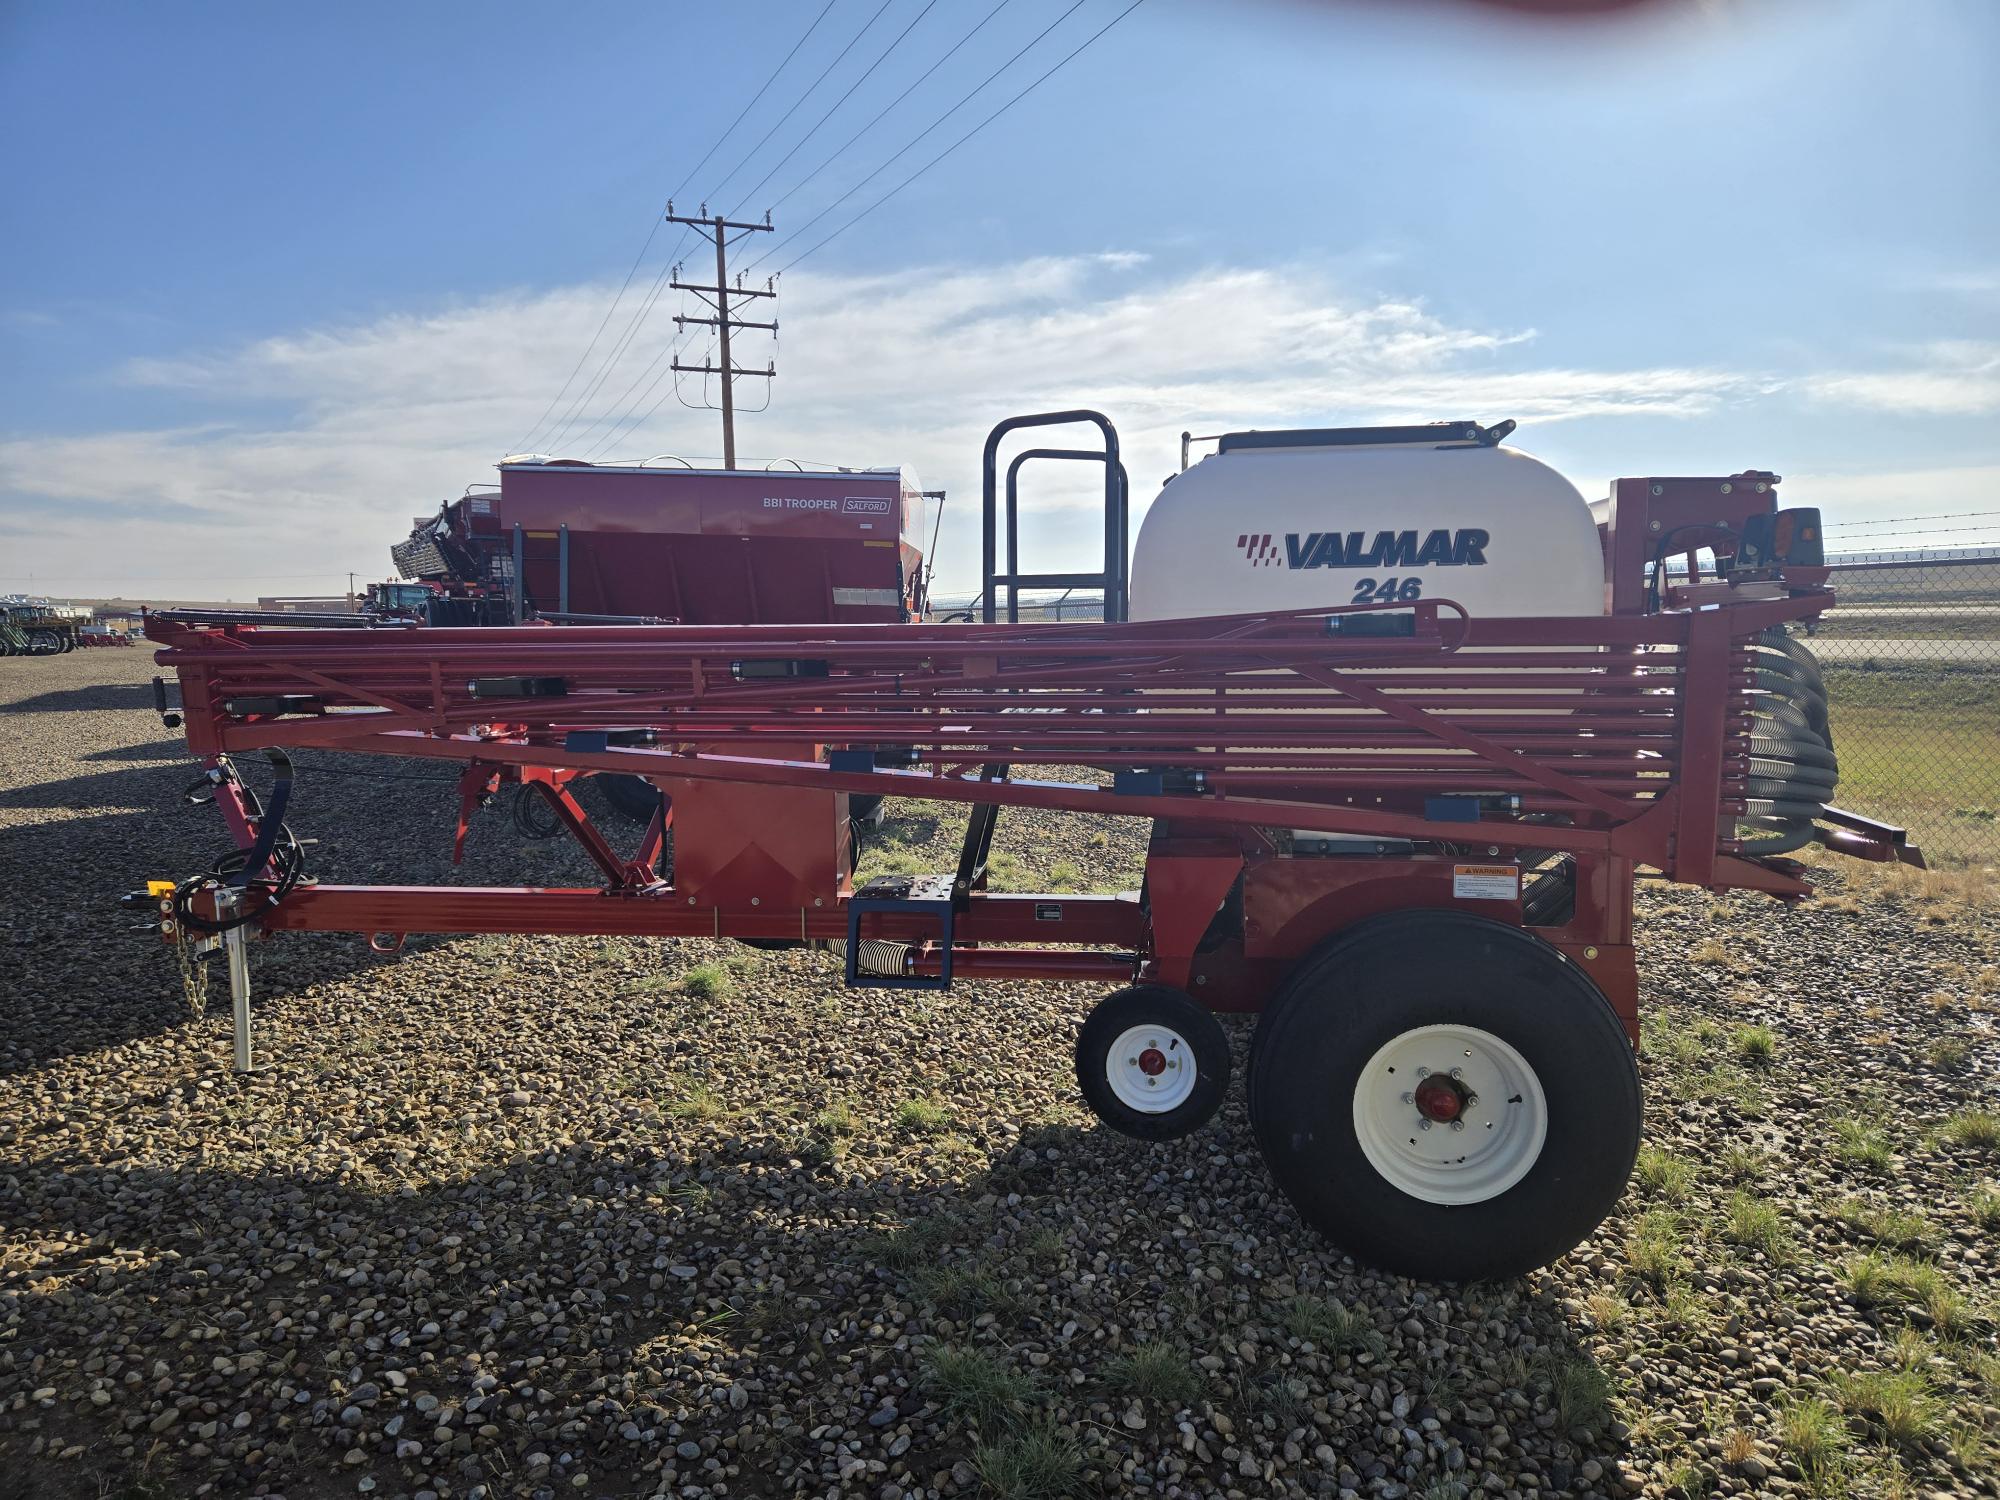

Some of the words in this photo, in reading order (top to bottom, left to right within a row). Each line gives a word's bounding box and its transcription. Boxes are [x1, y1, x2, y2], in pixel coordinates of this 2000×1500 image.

[763, 498, 782, 508] BBI
[785, 498, 838, 510] TROOPER
[846, 500, 887, 511] SALFORD
[1285, 528, 1490, 569] VALMAR
[1351, 577, 1423, 604] 246
[1472, 867, 1508, 875] WARNING
